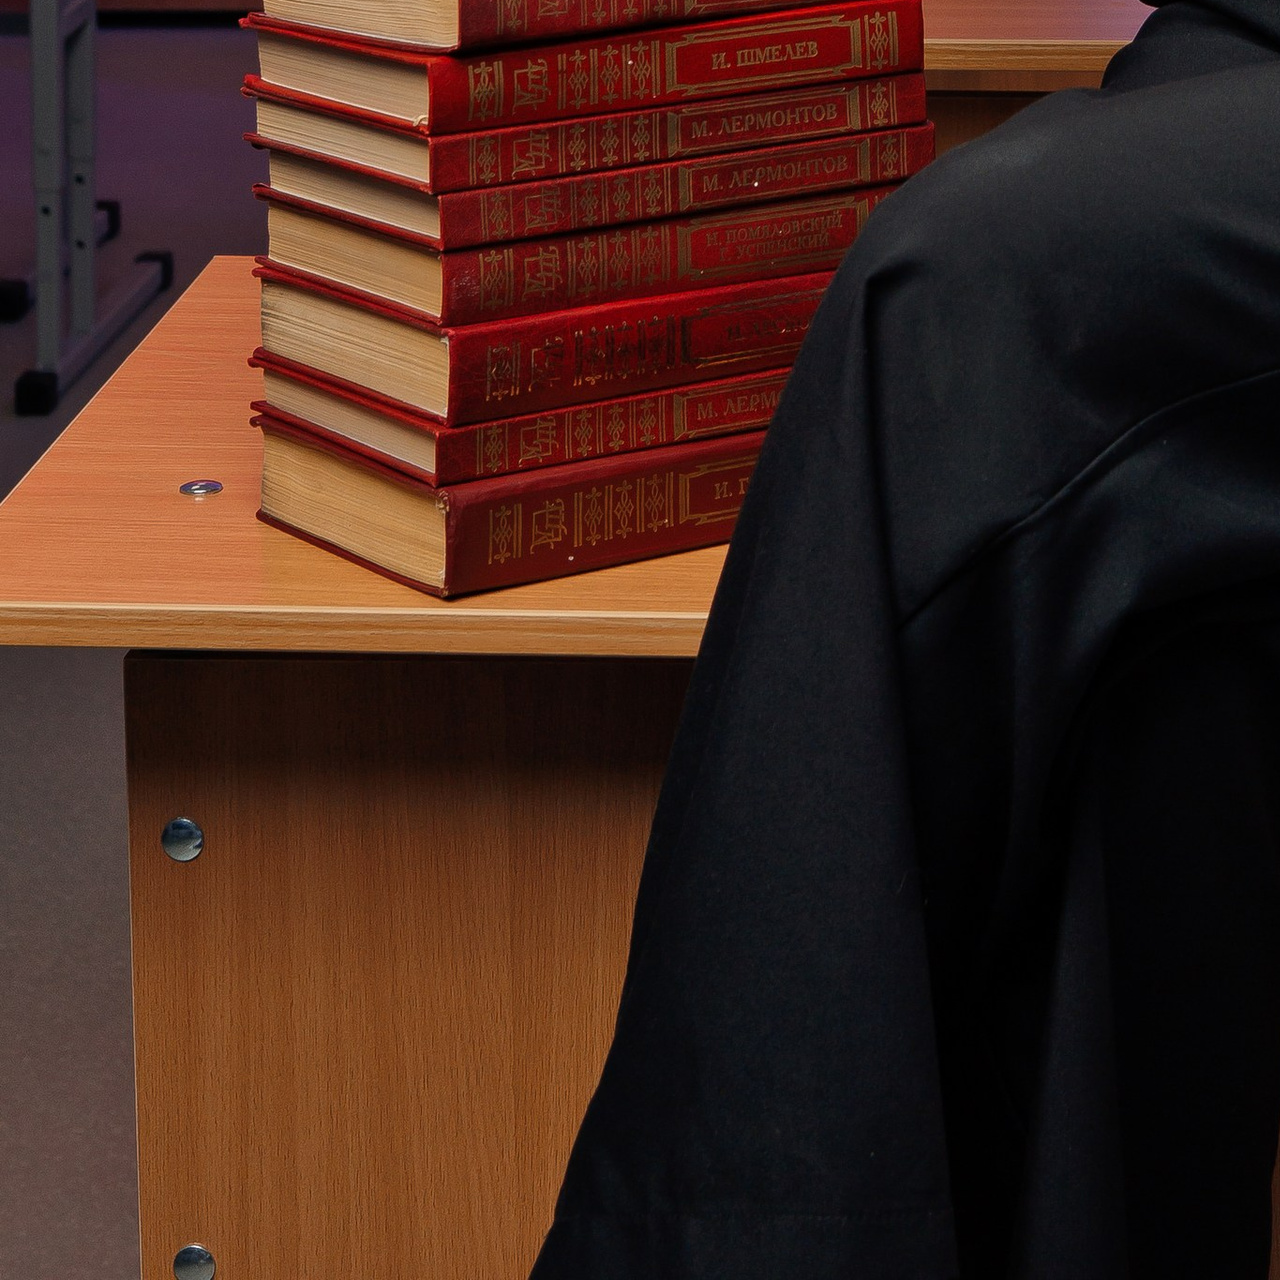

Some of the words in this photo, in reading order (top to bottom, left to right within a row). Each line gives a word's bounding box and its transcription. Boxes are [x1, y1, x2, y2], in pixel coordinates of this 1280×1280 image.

[711, 52, 731, 70] И.
[736, 41, 819, 67] ШМЕЛЕВ
[691, 120, 713, 138] М.
[718, 103, 838, 135] ЛЕРМОНТОВ
[702, 174, 724, 193] М.
[729, 154, 849, 189] ЛЕРМОНТОВ
[725, 211, 844, 245] ПОМЯЛОВСКИЙ
[736, 230, 830, 259] УСПЕНСКИЙ
[697, 401, 718, 421] М.
